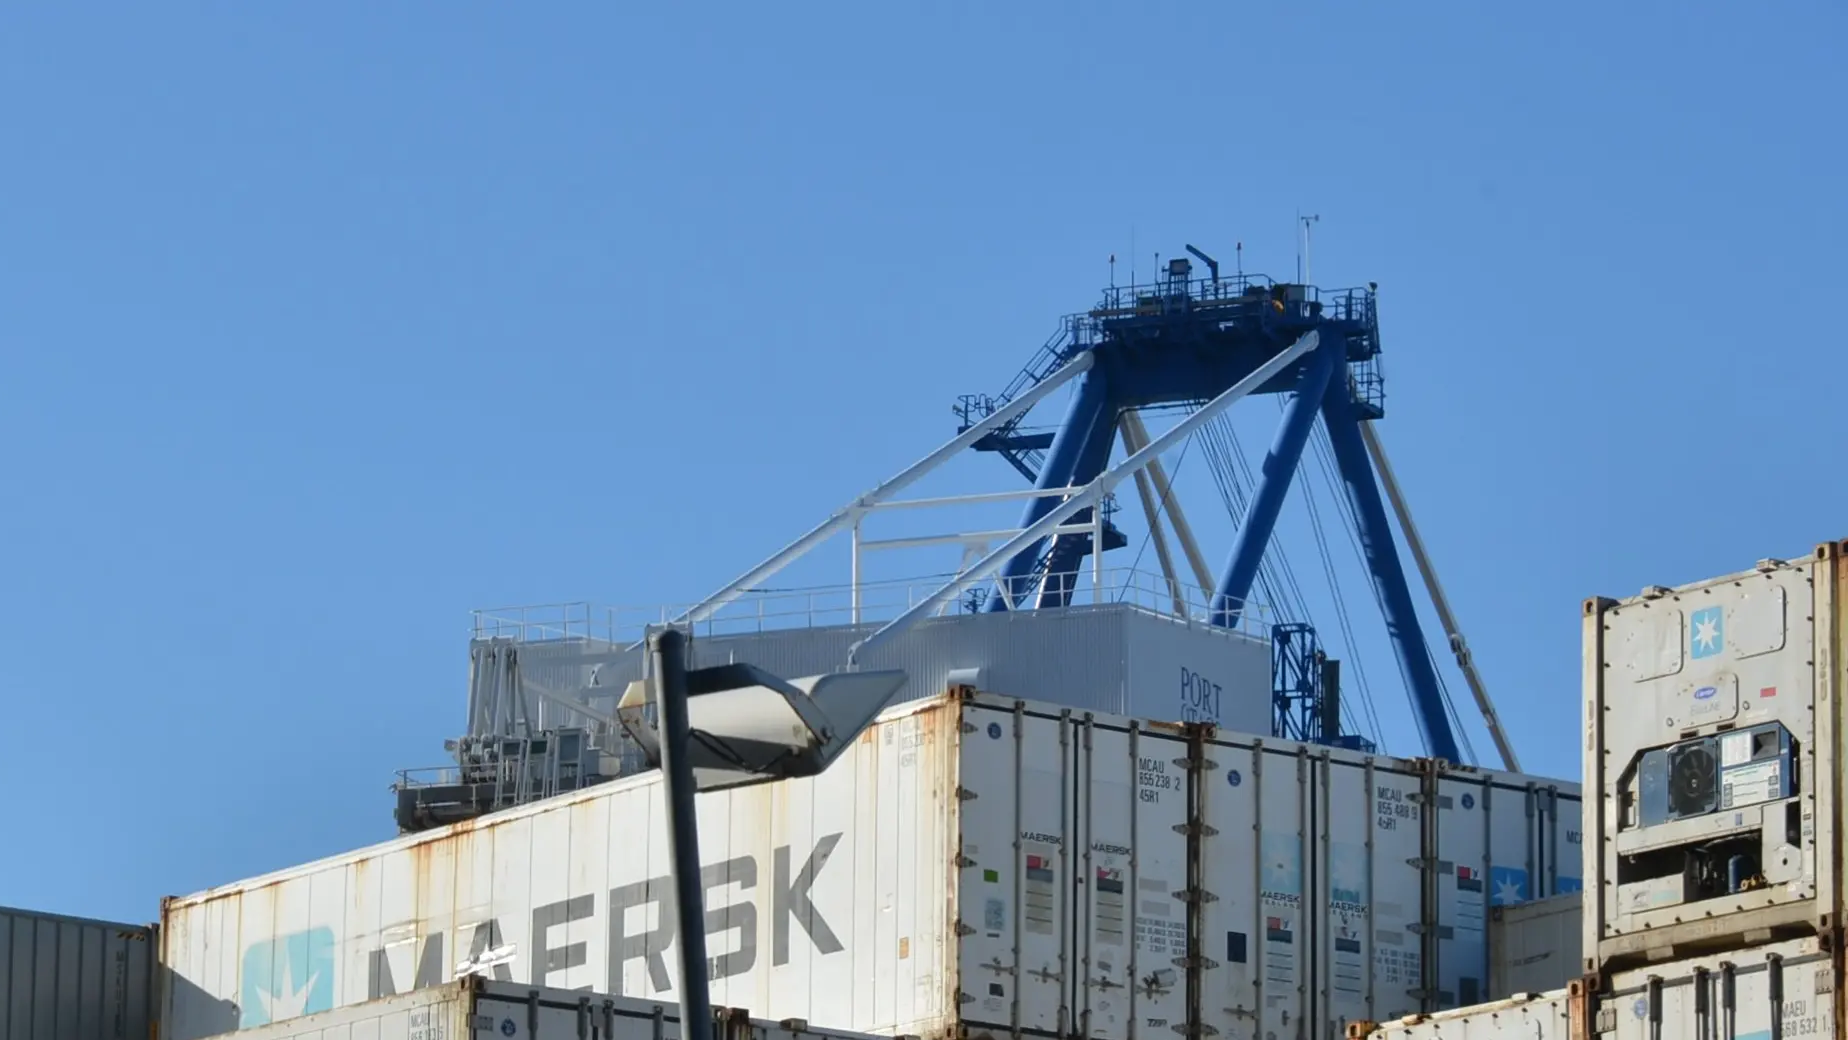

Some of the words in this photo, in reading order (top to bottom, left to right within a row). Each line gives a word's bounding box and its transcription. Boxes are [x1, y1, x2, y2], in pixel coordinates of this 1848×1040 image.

[1180, 665, 1223, 719] PORT
[1139, 758, 1164, 774] MCAU
[1139, 772, 1154, 787] 855
[1155, 774, 1170, 789] 238
[1175, 777, 1180, 791] 2
[1139, 788, 1159, 804] 45R1
[1378, 786, 1402, 803] MCAU
[1566, 829, 1583, 846] MC
[368, 831, 845, 1000] MAERSK
[1800, 1016, 1818, 1035] 532
